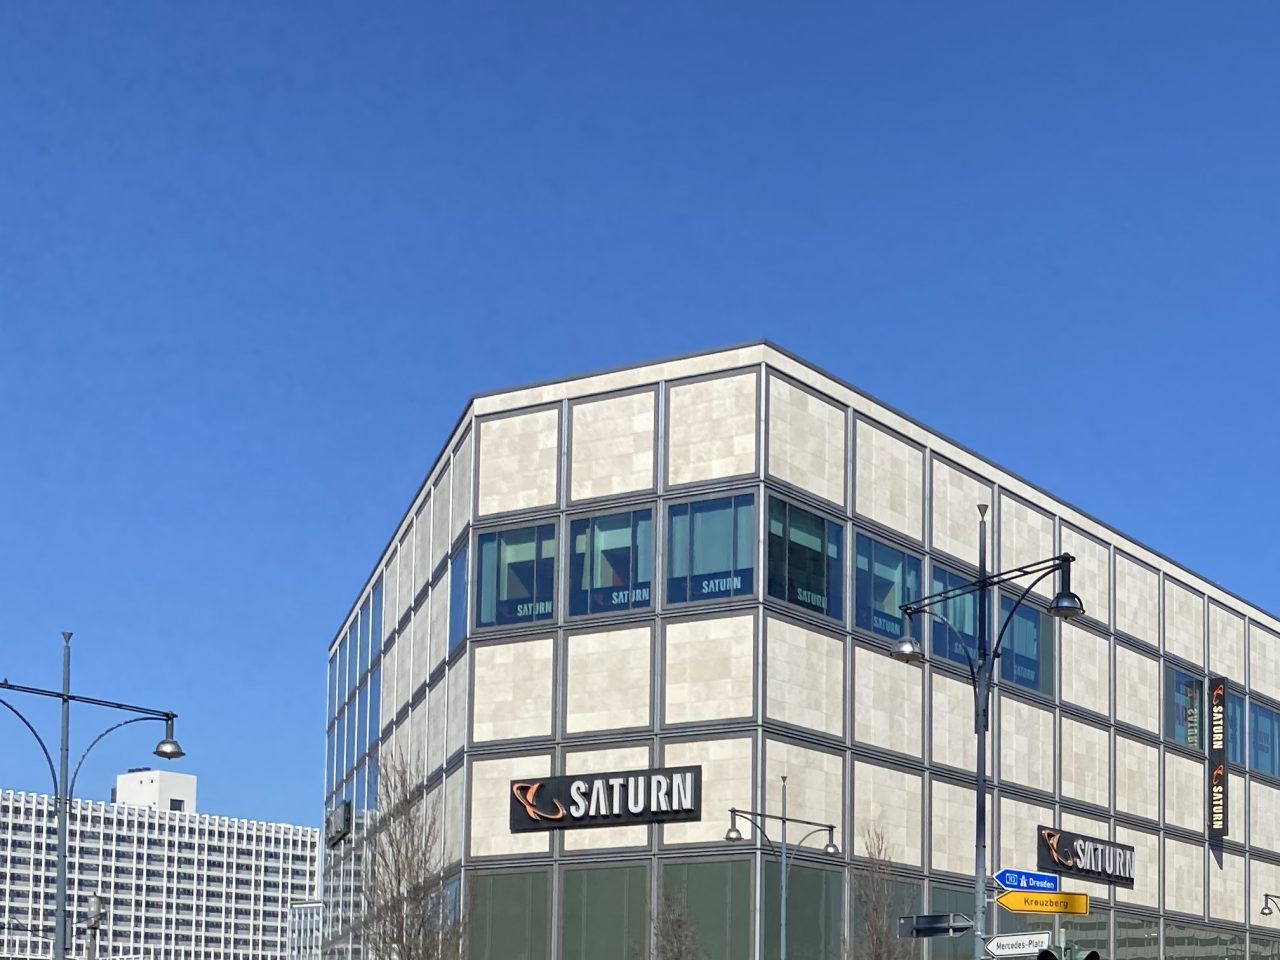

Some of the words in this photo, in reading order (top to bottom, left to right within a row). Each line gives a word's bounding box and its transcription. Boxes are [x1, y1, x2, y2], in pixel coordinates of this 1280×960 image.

[701, 577, 741, 594] SATURN
[612, 587, 650, 605] SATURN
[796, 588, 828, 609] SATURN
[517, 601, 552, 617] SATURN
[1212, 705, 1223, 749] SATURN
[569, 772, 694, 819] SATURN
[1212, 785, 1223, 829] SATURN
[1074, 839, 1135, 878] SATURN
[1029, 878, 1055, 889] Dresden
[1023, 897, 1069, 909] Kreuzberg
[996, 940, 1044, 950] Mercedes-Platz
